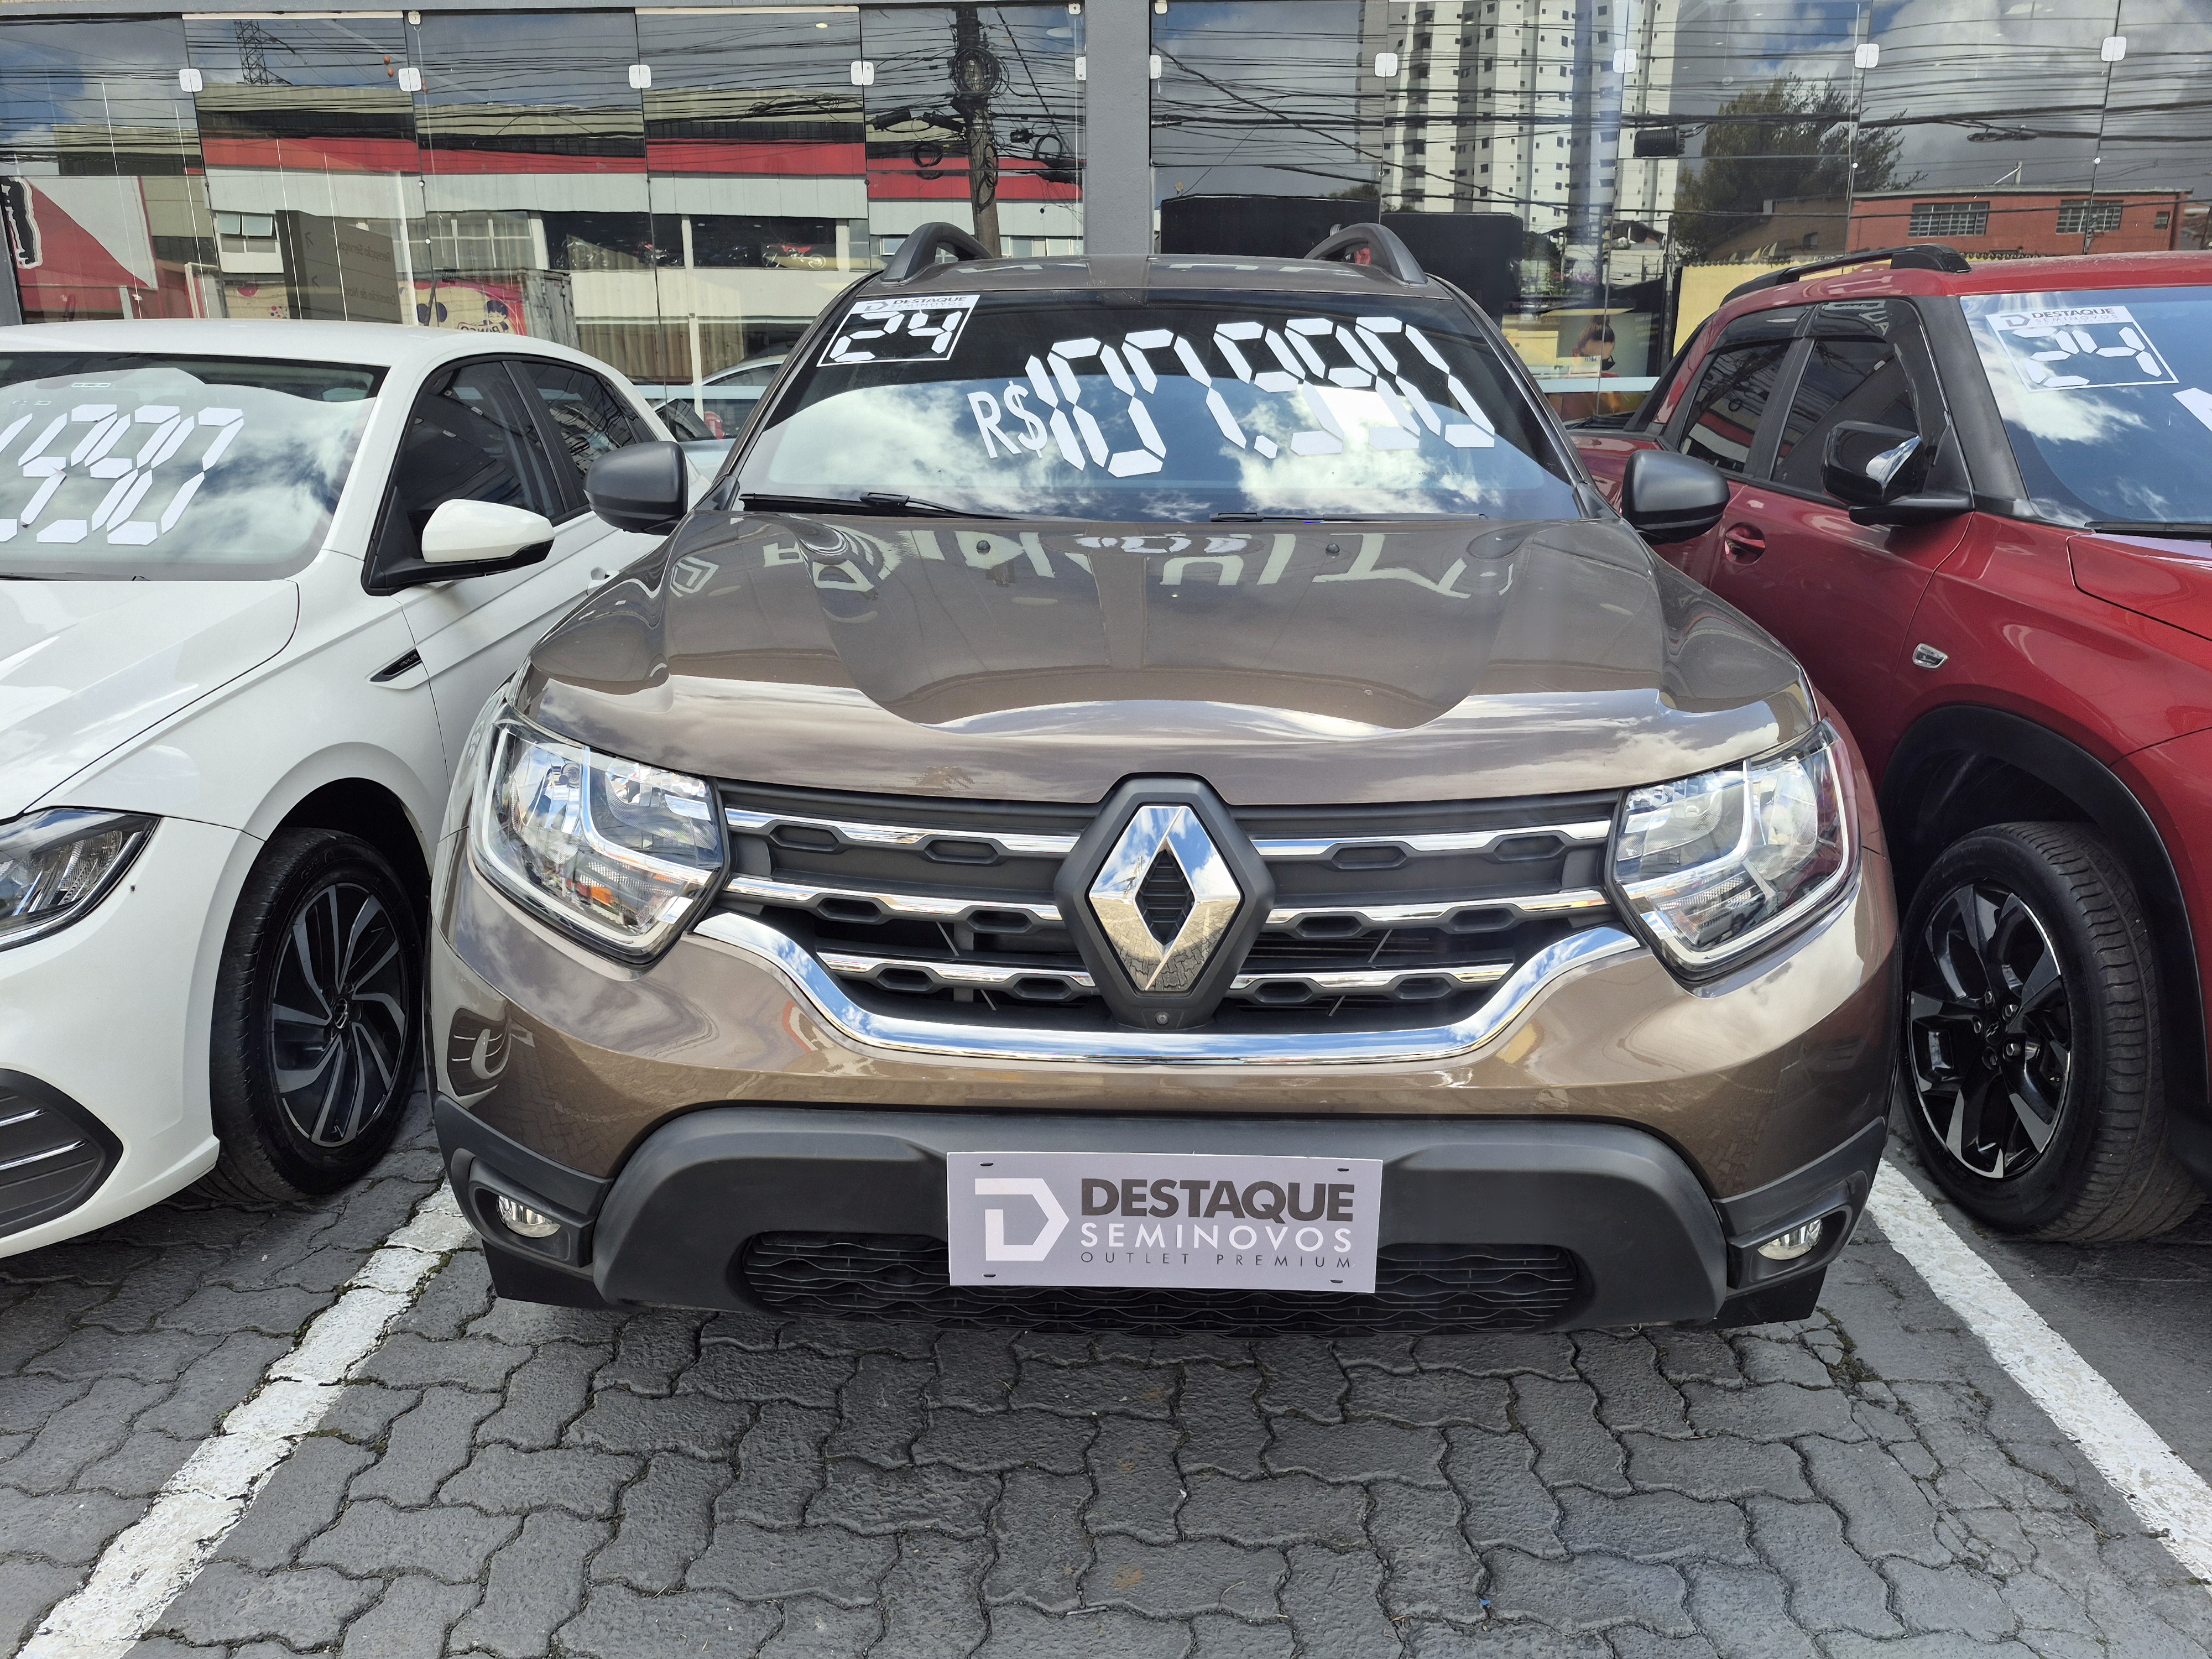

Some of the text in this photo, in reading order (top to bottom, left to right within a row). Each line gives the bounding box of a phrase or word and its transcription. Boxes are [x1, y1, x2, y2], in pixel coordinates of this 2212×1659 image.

[893, 296, 967, 305] DESTAQUE
[2031, 308, 2115, 319] DESTAQUE
[2035, 315, 2118, 323] SEMINOVOS
[830, 311, 963, 363] 24
[2011, 326, 2162, 388] 24
[1081, 1178, 1355, 1224] DESTAQUE
[1081, 1222, 1352, 1253] SEMINOVOS
[1081, 1251, 1351, 1269] OUTLET PREMIUM
